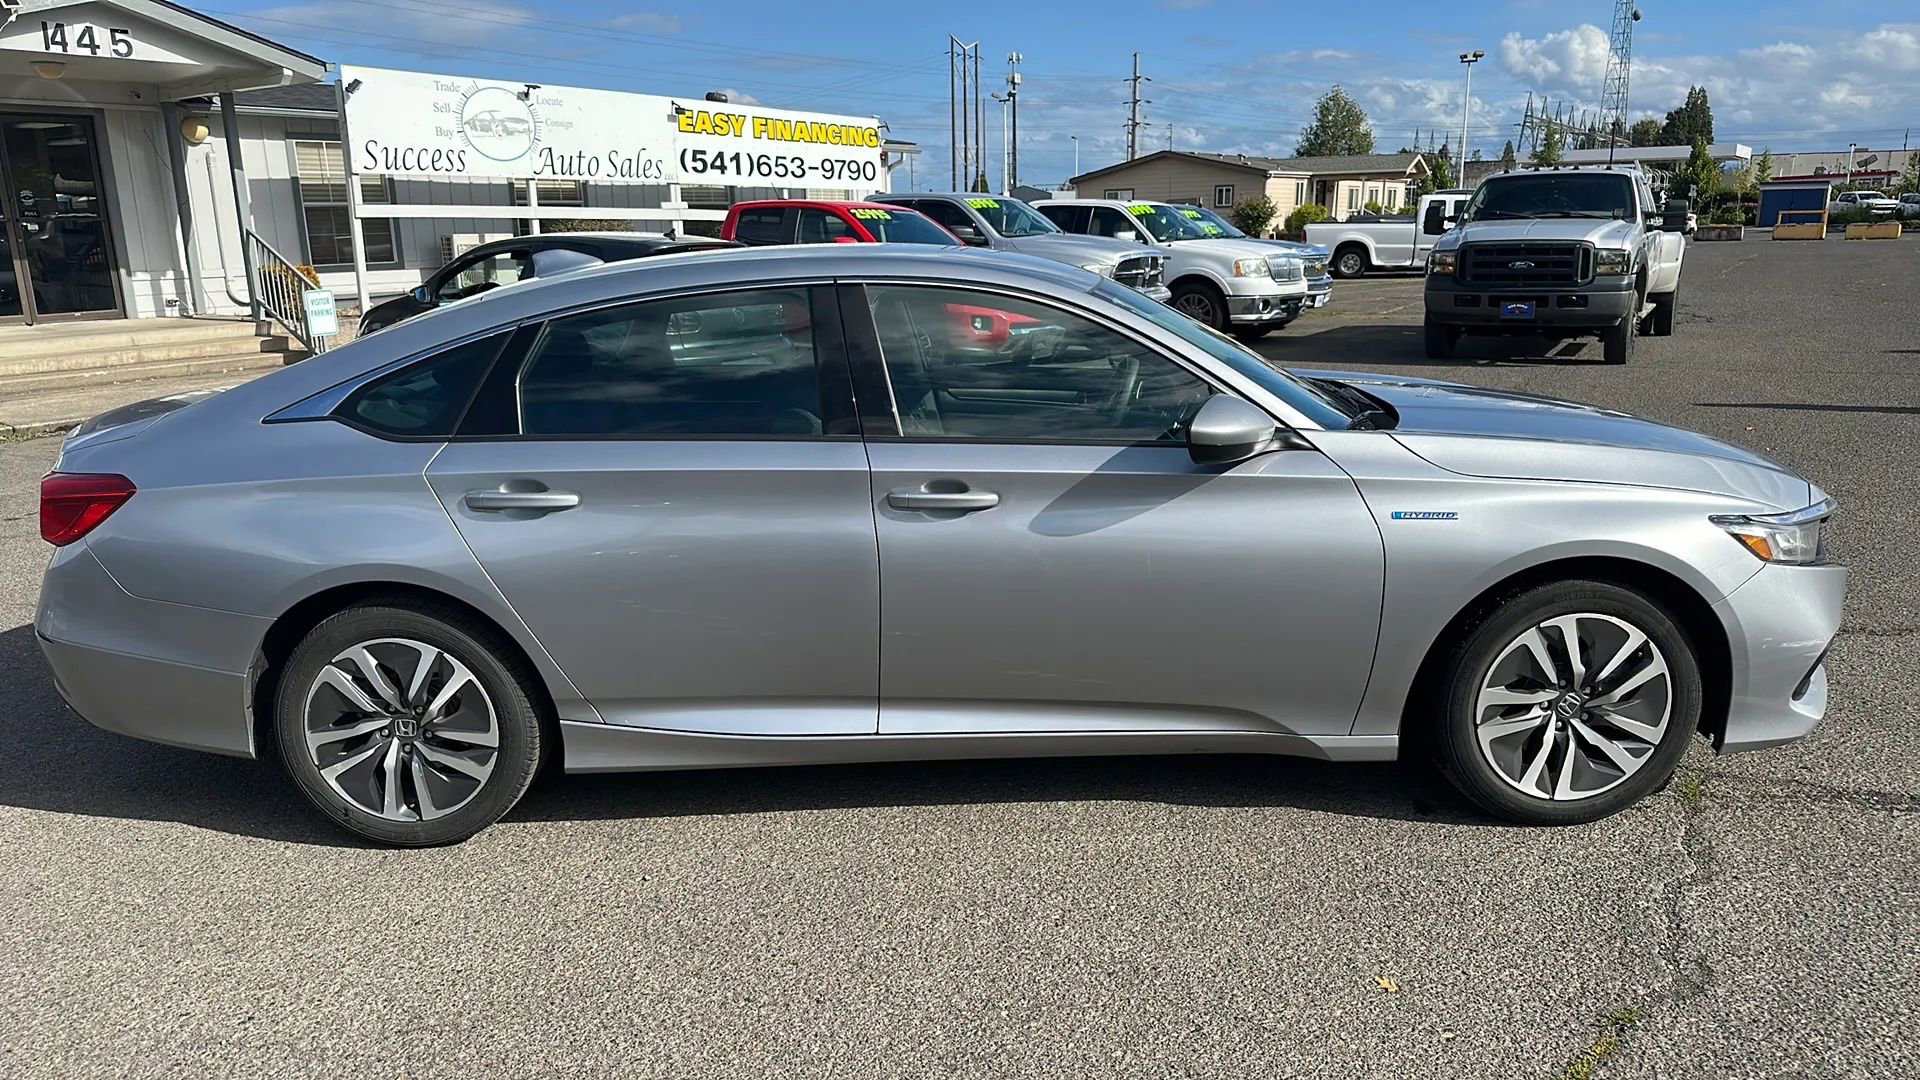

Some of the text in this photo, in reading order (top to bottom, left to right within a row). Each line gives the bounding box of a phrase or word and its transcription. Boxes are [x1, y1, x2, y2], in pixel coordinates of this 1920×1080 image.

[41, 21, 133, 58] 1445
[433, 80, 461, 93] Trade
[433, 102, 451, 113] Sell
[536, 95, 564, 107] Locate
[545, 118, 574, 130] Consign
[678, 110, 880, 148] EASY FINANCING
[435, 126, 455, 140] Buy
[363, 139, 466, 172] Success
[533, 147, 600, 177] Auto
[606, 148, 663, 179] Sales
[680, 148, 876, 181] (541)653-9790
[1400, 511, 1458, 520] HYBRID
